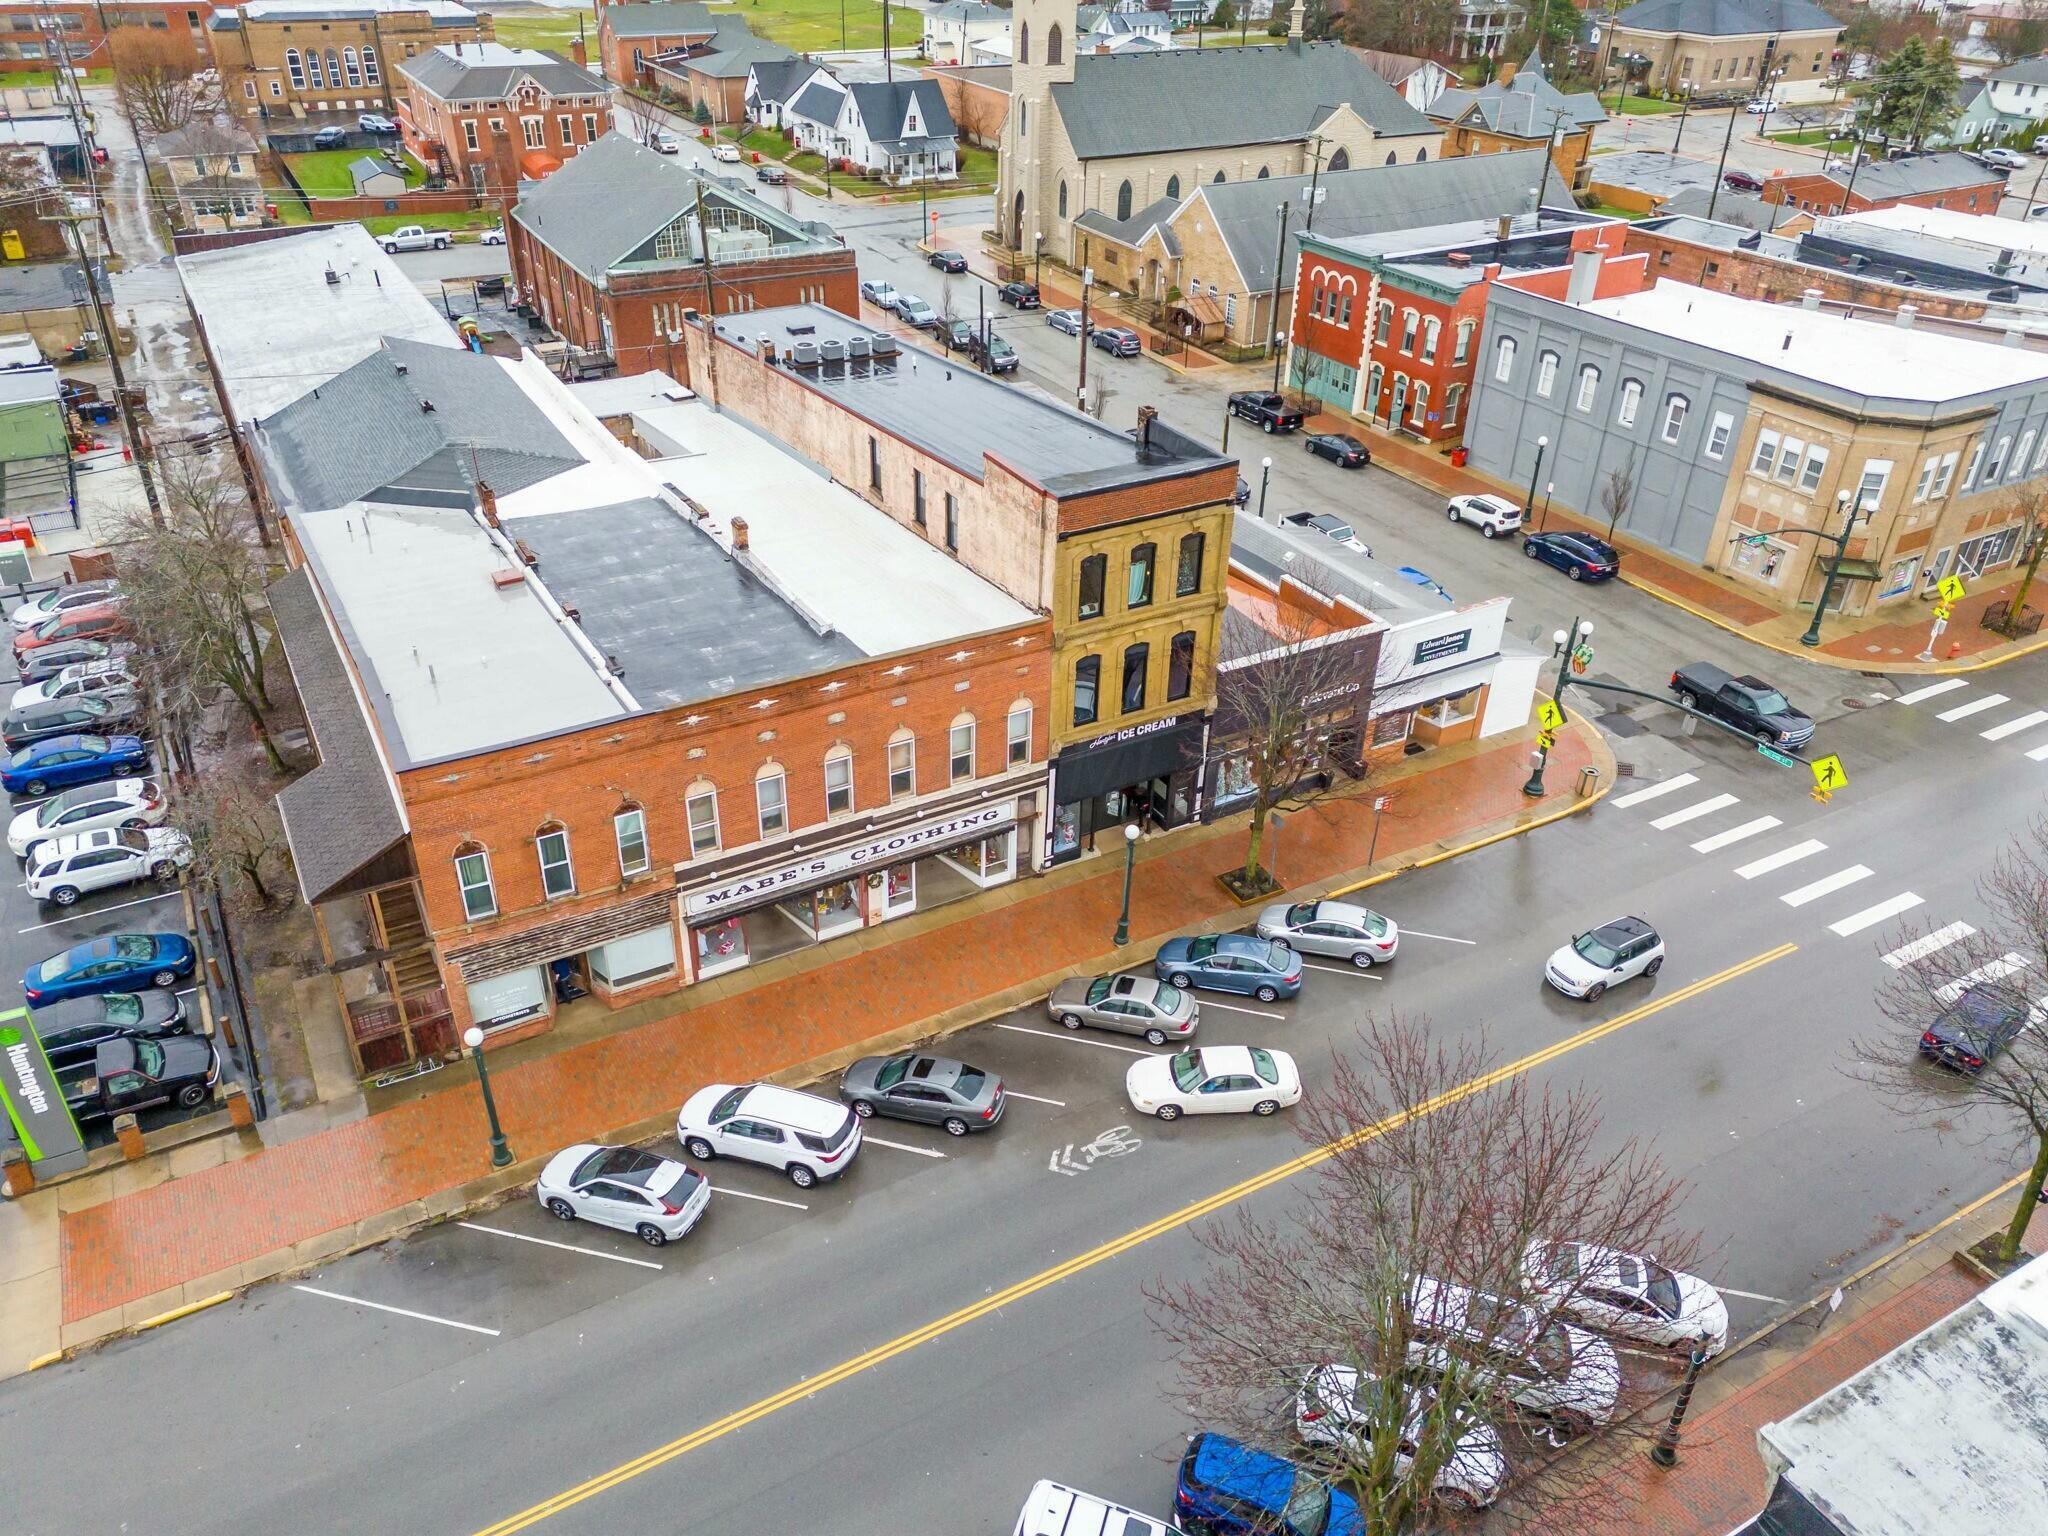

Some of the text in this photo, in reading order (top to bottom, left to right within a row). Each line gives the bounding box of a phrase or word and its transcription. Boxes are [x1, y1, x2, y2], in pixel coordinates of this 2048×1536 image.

[1422, 633, 1465, 650] Edward Jones
[1423, 647, 1458, 661] INVESTMENTS
[1117, 717, 1176, 742] ICE CREAM
[706, 810, 999, 905] MABE'S CLOTHING
[491, 1008, 530, 1024] OPTOMETRISTS
[6, 1042, 49, 1115] Huntington
